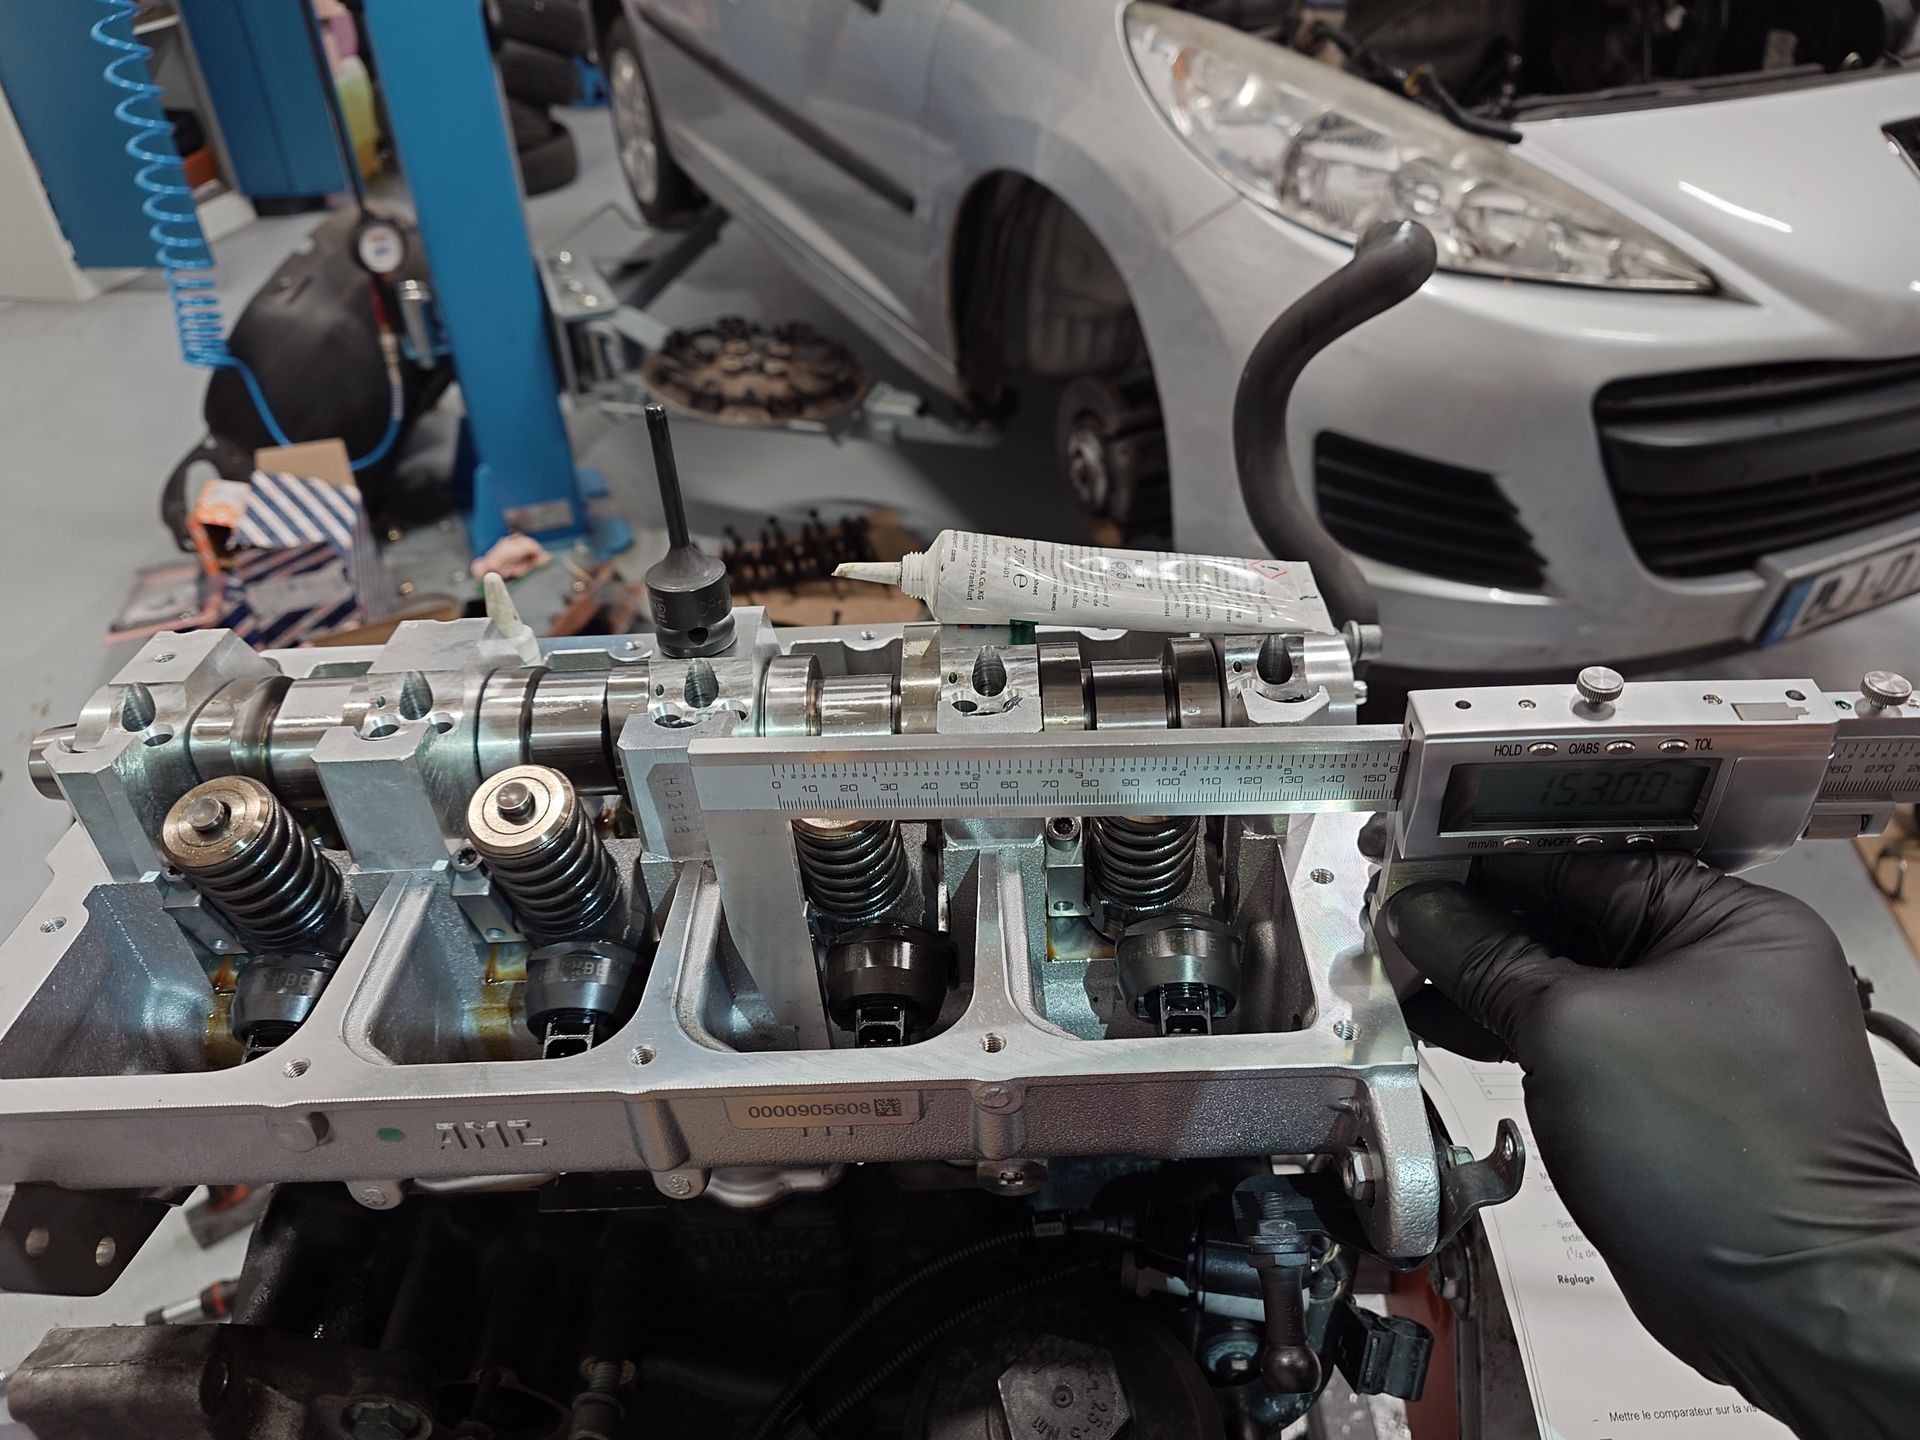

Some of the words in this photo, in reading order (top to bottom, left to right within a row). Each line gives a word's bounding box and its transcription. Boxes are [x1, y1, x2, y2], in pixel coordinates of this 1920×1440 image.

[967, 568, 976, 601] Frankfurt
[978, 577, 986, 589] Co.
[977, 590, 984, 600] KG
[1494, 744, 1522, 756] HOLD
[1694, 738, 1713, 751] TOL
[771, 781, 781, 789] 0
[839, 784, 858, 792] 20
[879, 783, 898, 791] 30
[920, 782, 939, 790] 40
[960, 781, 978, 790] 50
[1000, 781, 1019, 789] 60
[1040, 780, 1059, 788] 70
[1081, 779, 1099, 787] 80
[1121, 778, 1140, 787] 90
[1155, 778, 1180, 786] 100
[1199, 777, 1222, 785] 110
[1237, 776, 1263, 785] 120
[1278, 775, 1304, 784] 130
[1320, 775, 1345, 783] 140
[1362, 774, 1387, 782] 150
[1467, 839, 1499, 849] mm/in
[1536, 837, 1573, 848] ON/OFF
[1660, 834, 1680, 844] PRE
[748, 1102, 872, 1119] 0000905608
[434, 1119, 547, 1149] AMC
[1557, 1273, 1595, 1286] Réglage
[1609, 1411, 1640, 1422] Mettre
[1642, 1409, 1651, 1420] le
[1653, 1406, 1712, 1421] comparateur
[1715, 1406, 1730, 1415] sur
[1733, 1403, 1741, 1414] la
